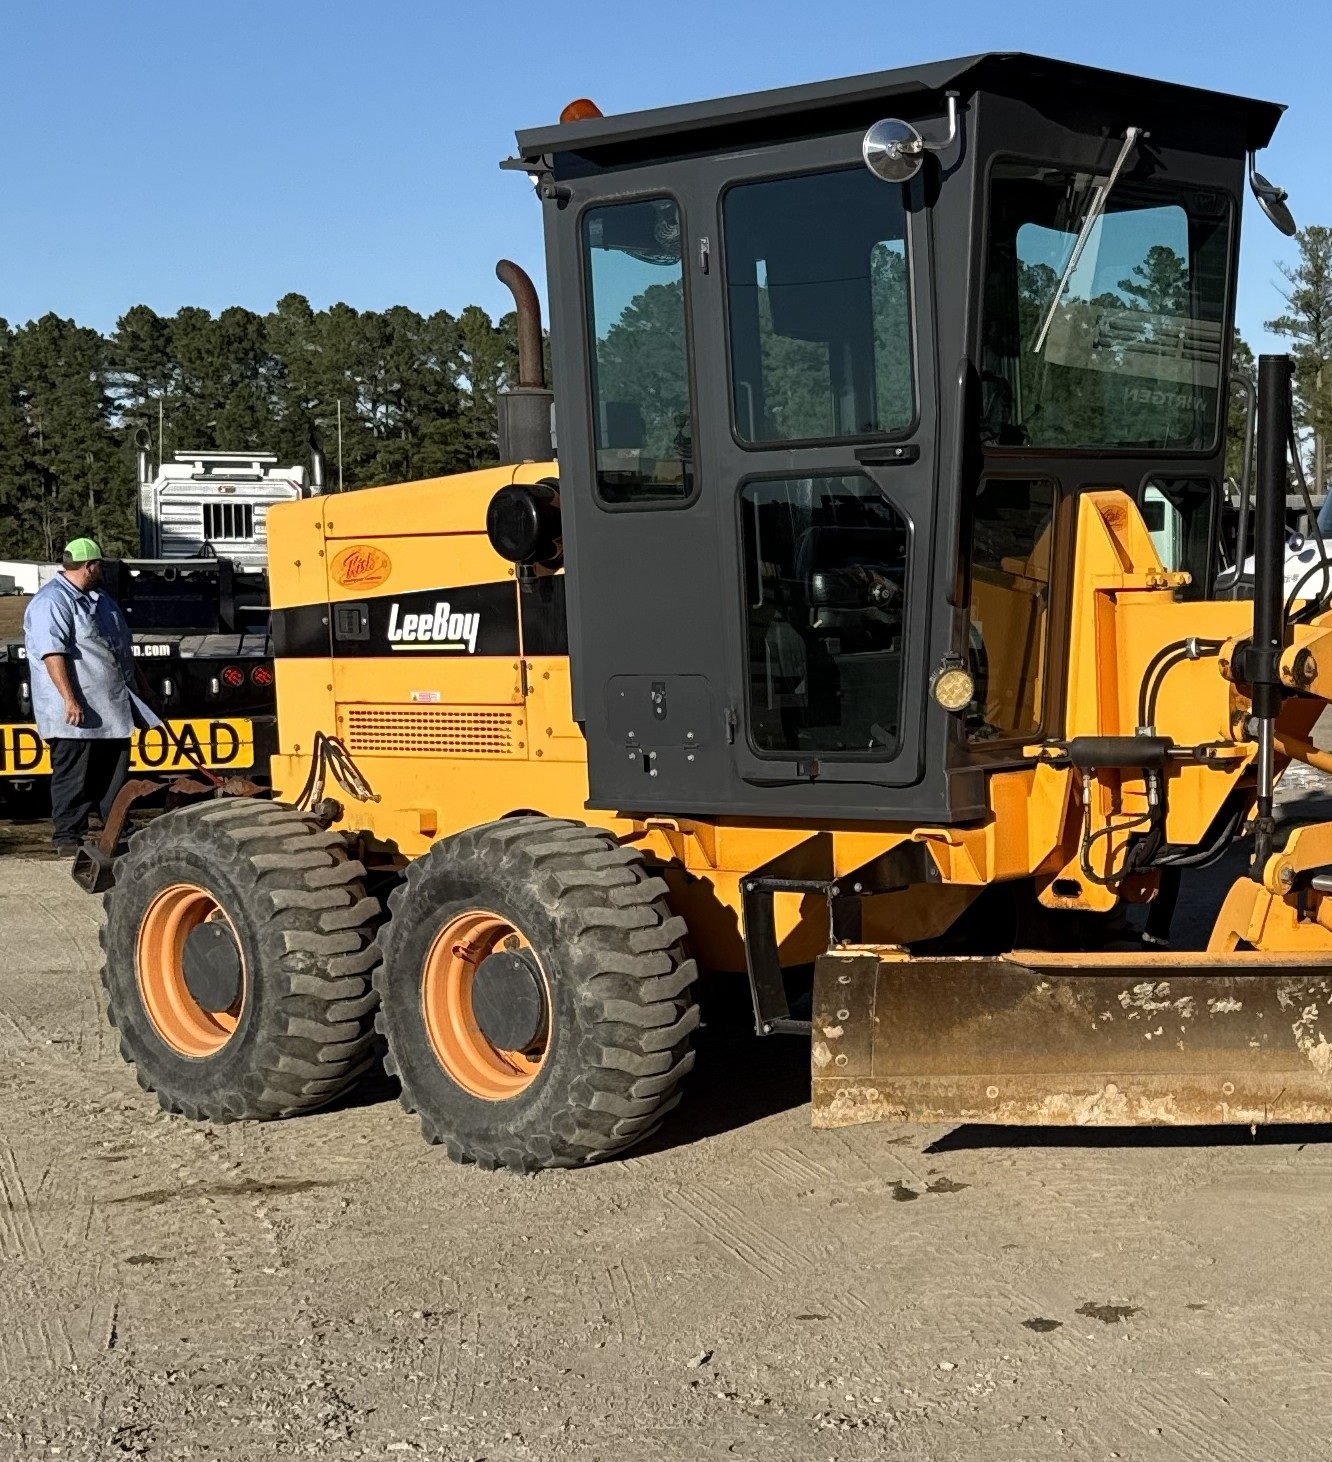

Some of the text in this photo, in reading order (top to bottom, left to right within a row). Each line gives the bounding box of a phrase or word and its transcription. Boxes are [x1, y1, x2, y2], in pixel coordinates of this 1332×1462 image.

[131, 644, 171, 657] n.com
[387, 602, 480, 653] LeeBoy
[0, 721, 240, 771] ID OAD
